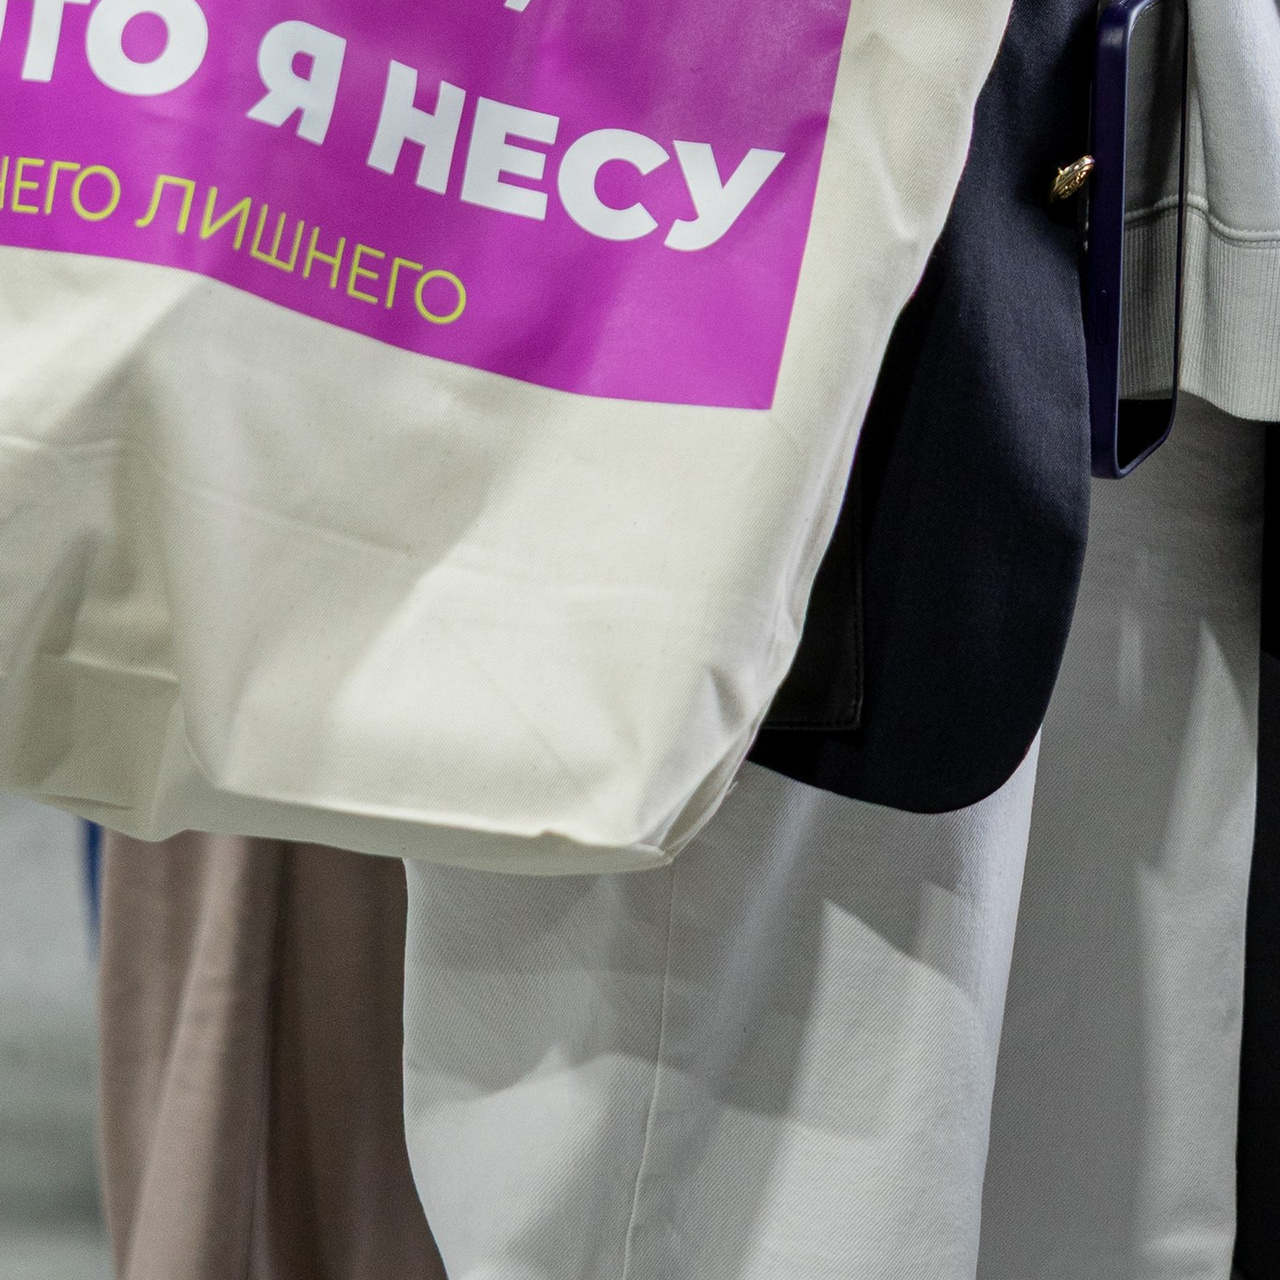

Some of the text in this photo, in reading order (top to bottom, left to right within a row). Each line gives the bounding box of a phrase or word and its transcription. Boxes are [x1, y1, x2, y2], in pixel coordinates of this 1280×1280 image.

[246, 20, 347, 144] Я
[366, 60, 786, 253] НЕСУ
[0, 155, 468, 327] ЕГО ЛИШНЕГО
